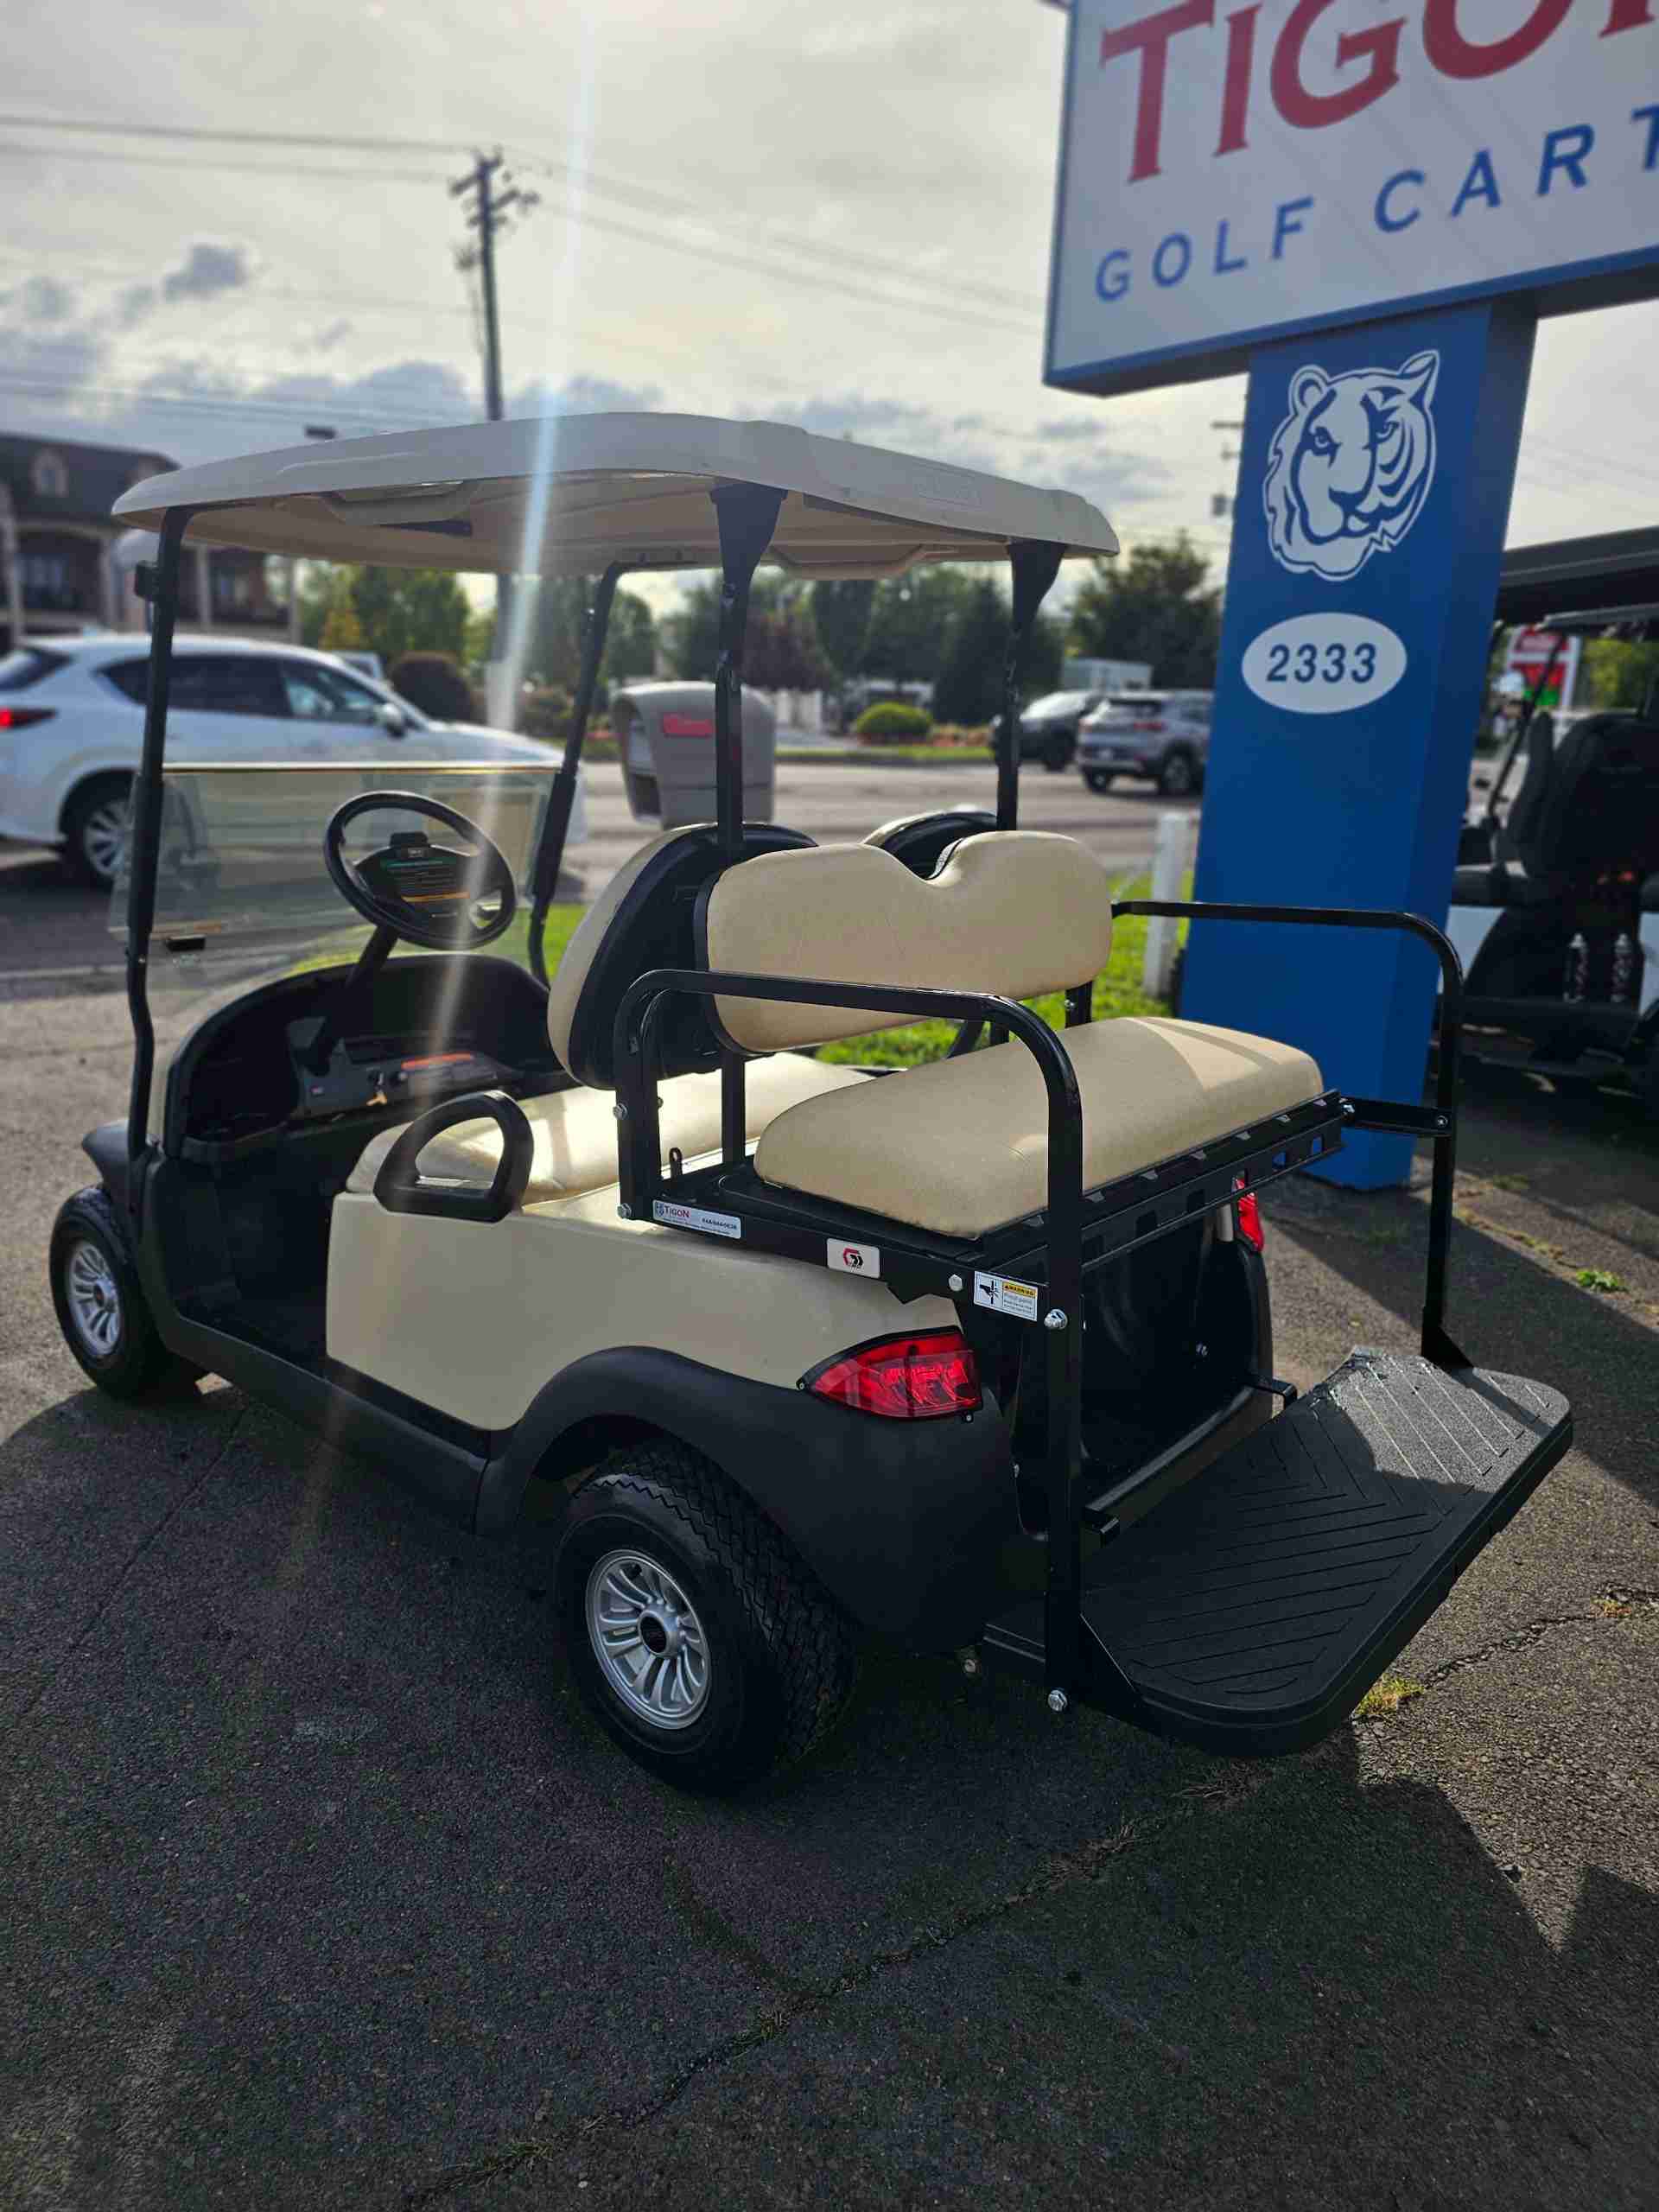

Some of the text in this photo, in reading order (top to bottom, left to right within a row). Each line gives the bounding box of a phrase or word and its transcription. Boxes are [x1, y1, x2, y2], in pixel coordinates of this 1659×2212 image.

[1100, 0, 1656, 183] TIGO
[1095, 103, 1659, 302] GOLF CART
[1266, 642, 1377, 684] 2333
